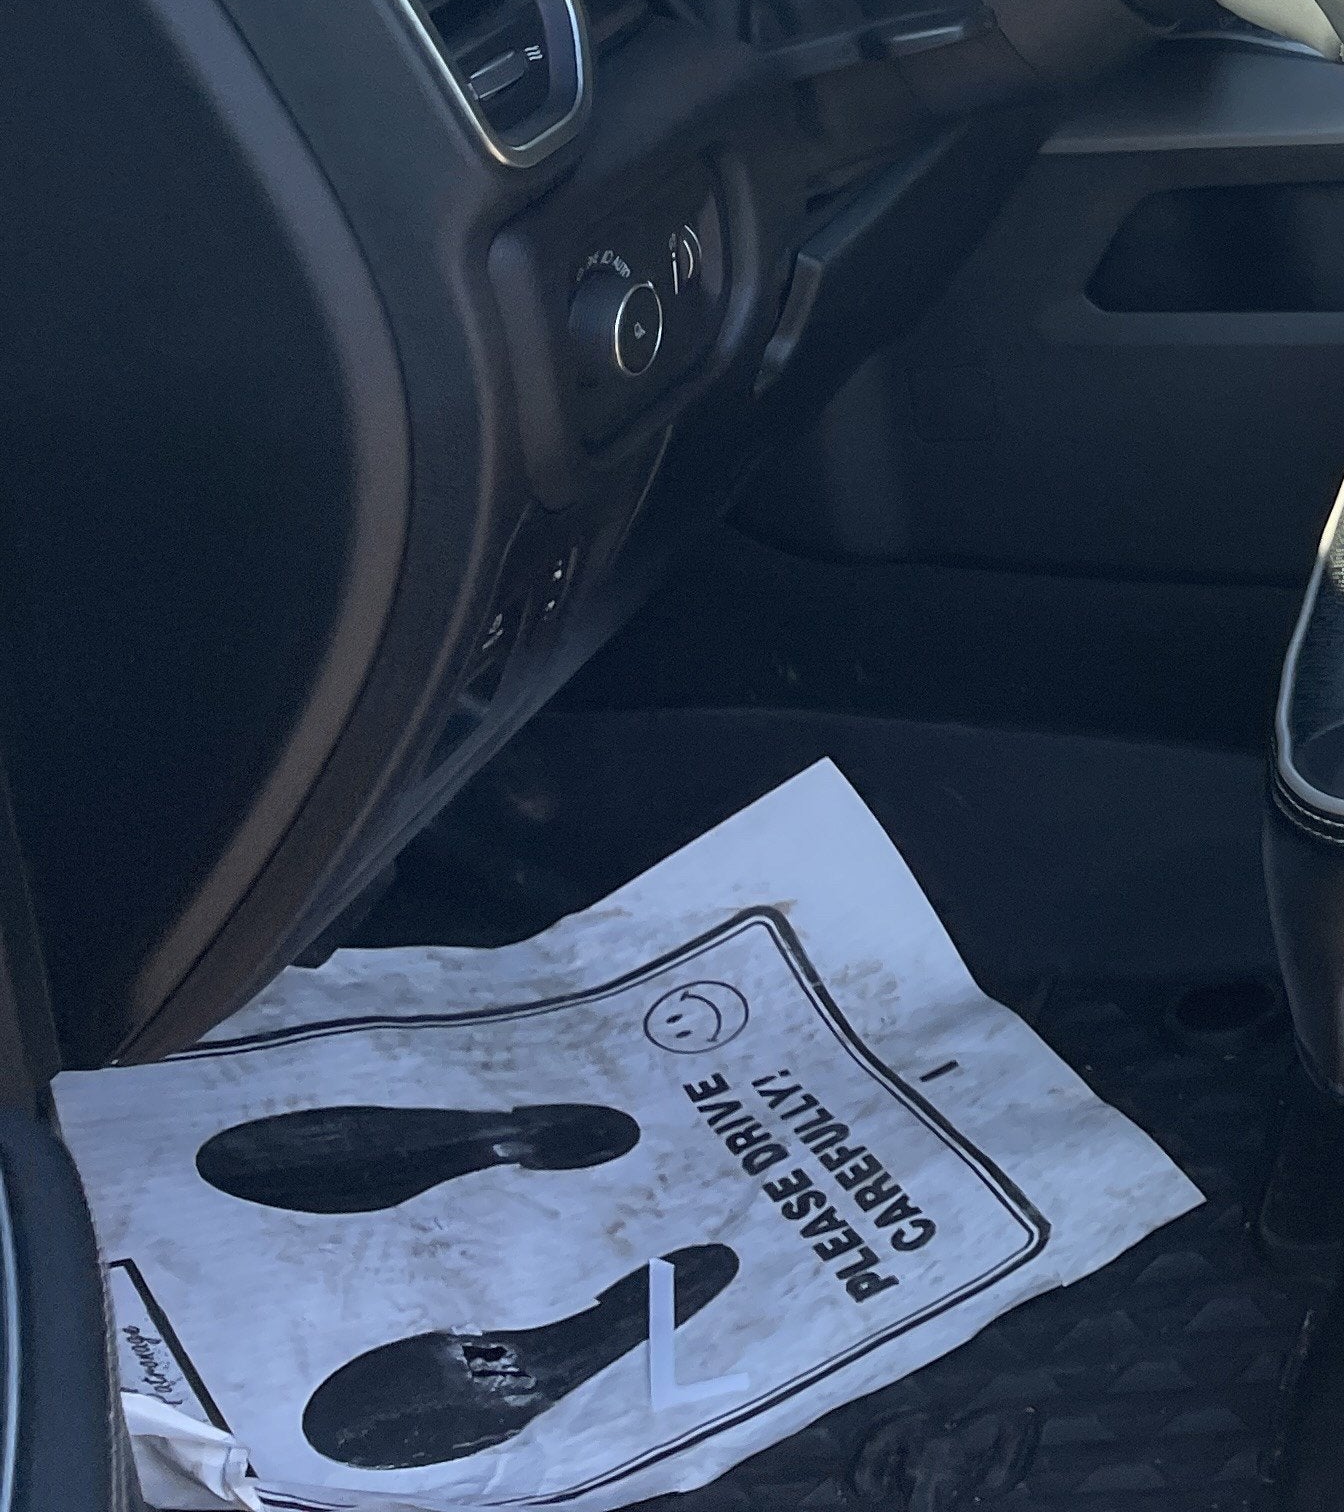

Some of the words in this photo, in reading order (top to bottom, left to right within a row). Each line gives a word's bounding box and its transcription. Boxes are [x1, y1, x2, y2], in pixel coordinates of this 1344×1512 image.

[683, 1073, 790, 1176] DRIVE
[751, 1069, 936, 1251] CAREFULLY!
[762, 1168, 899, 1303] PLEASE
